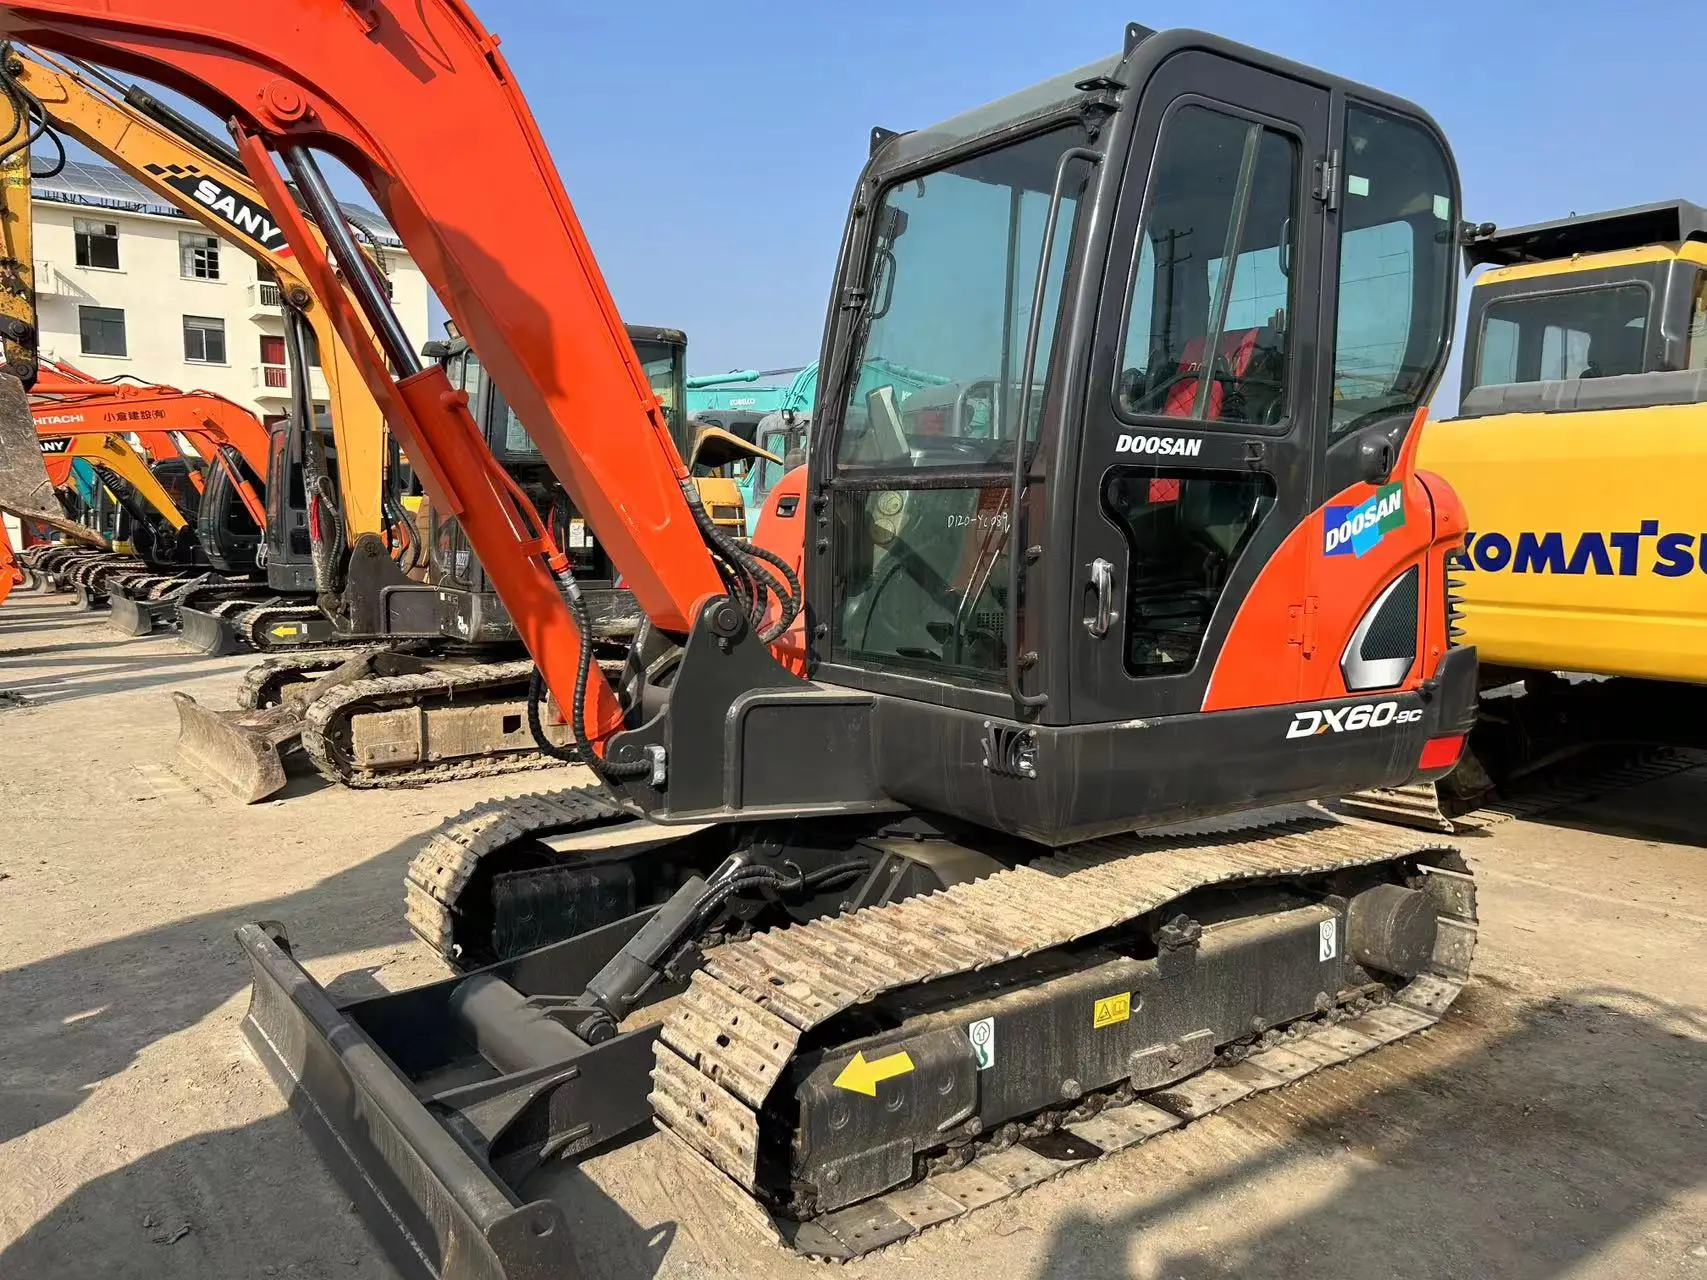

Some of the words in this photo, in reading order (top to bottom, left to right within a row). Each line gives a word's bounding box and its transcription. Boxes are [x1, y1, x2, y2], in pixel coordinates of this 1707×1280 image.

[193, 179, 282, 243] SANY
[33, 414, 84, 425] HITACHI
[1115, 434, 1202, 456] DOOSAN
[1325, 488, 1402, 553] DOOSAN
[1456, 520, 1707, 578] KOMATS
